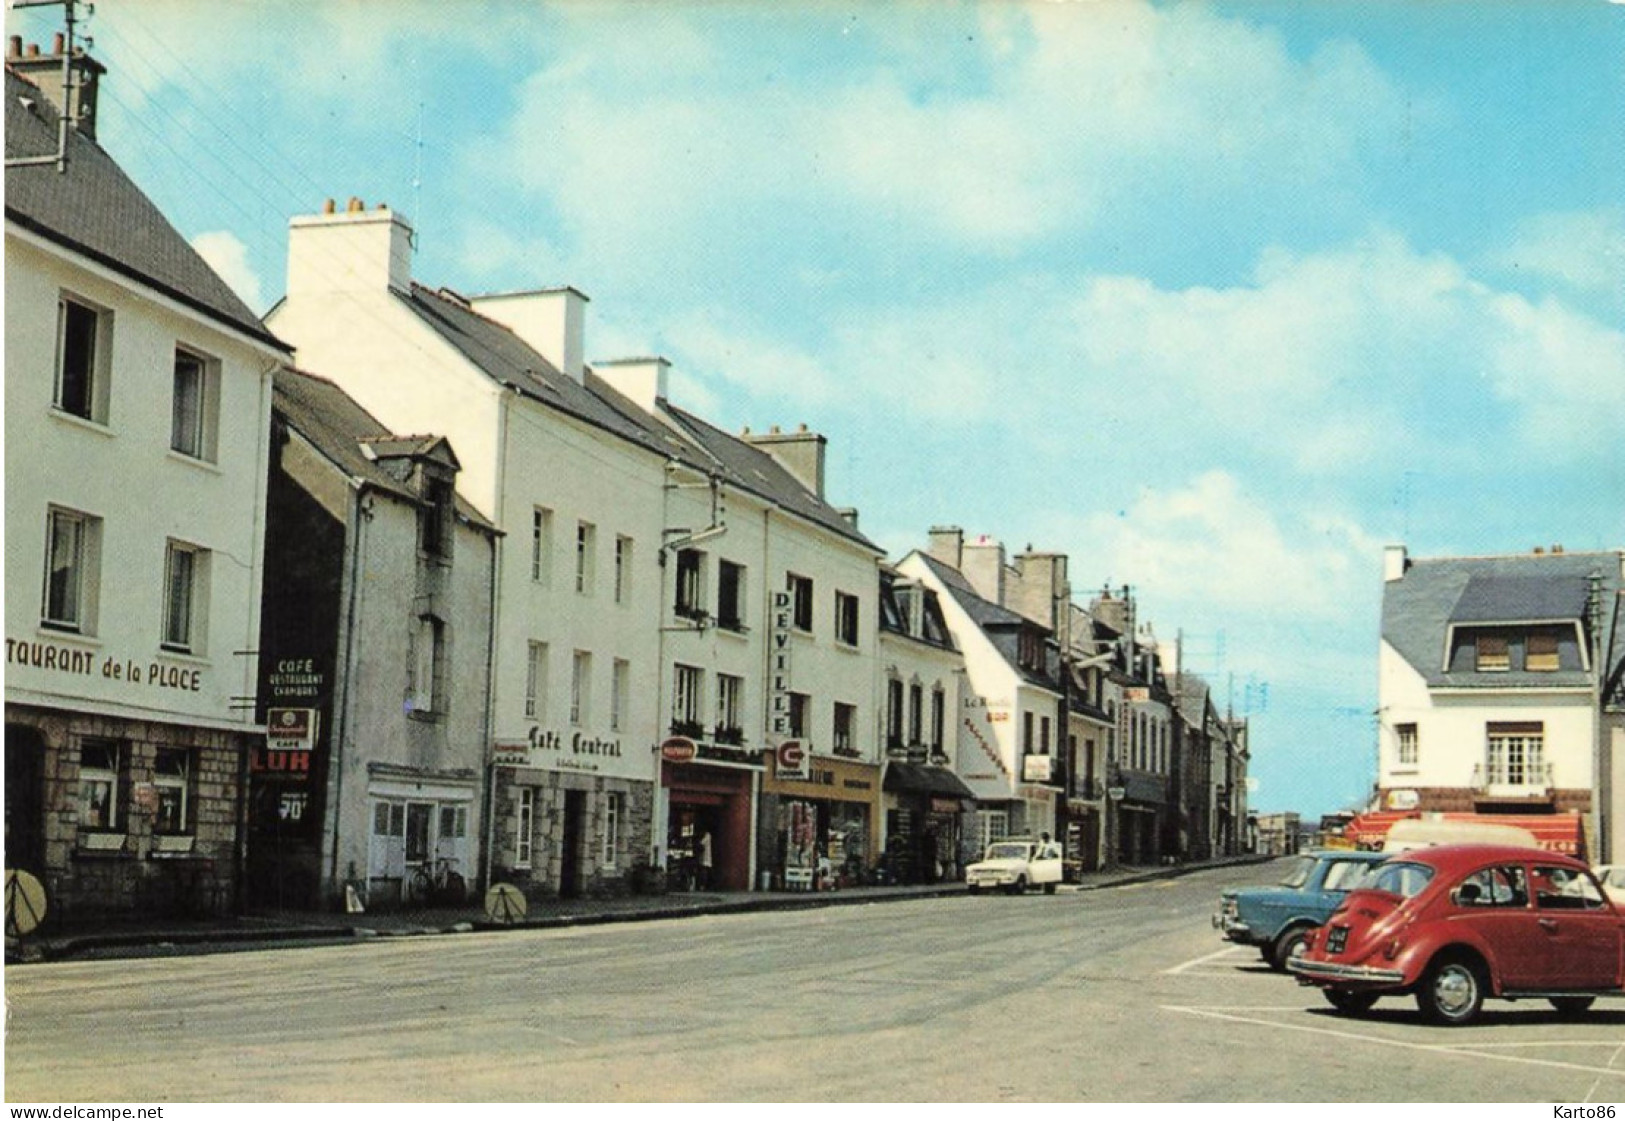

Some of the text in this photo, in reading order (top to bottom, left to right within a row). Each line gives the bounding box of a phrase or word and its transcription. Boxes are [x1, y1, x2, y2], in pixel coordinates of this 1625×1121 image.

[102, 656, 122, 682] de
[126, 659, 142, 683] la
[148, 663, 202, 692] PLACE
[774, 592, 790, 733] DEVILLE
[571, 732, 622, 758] Central
